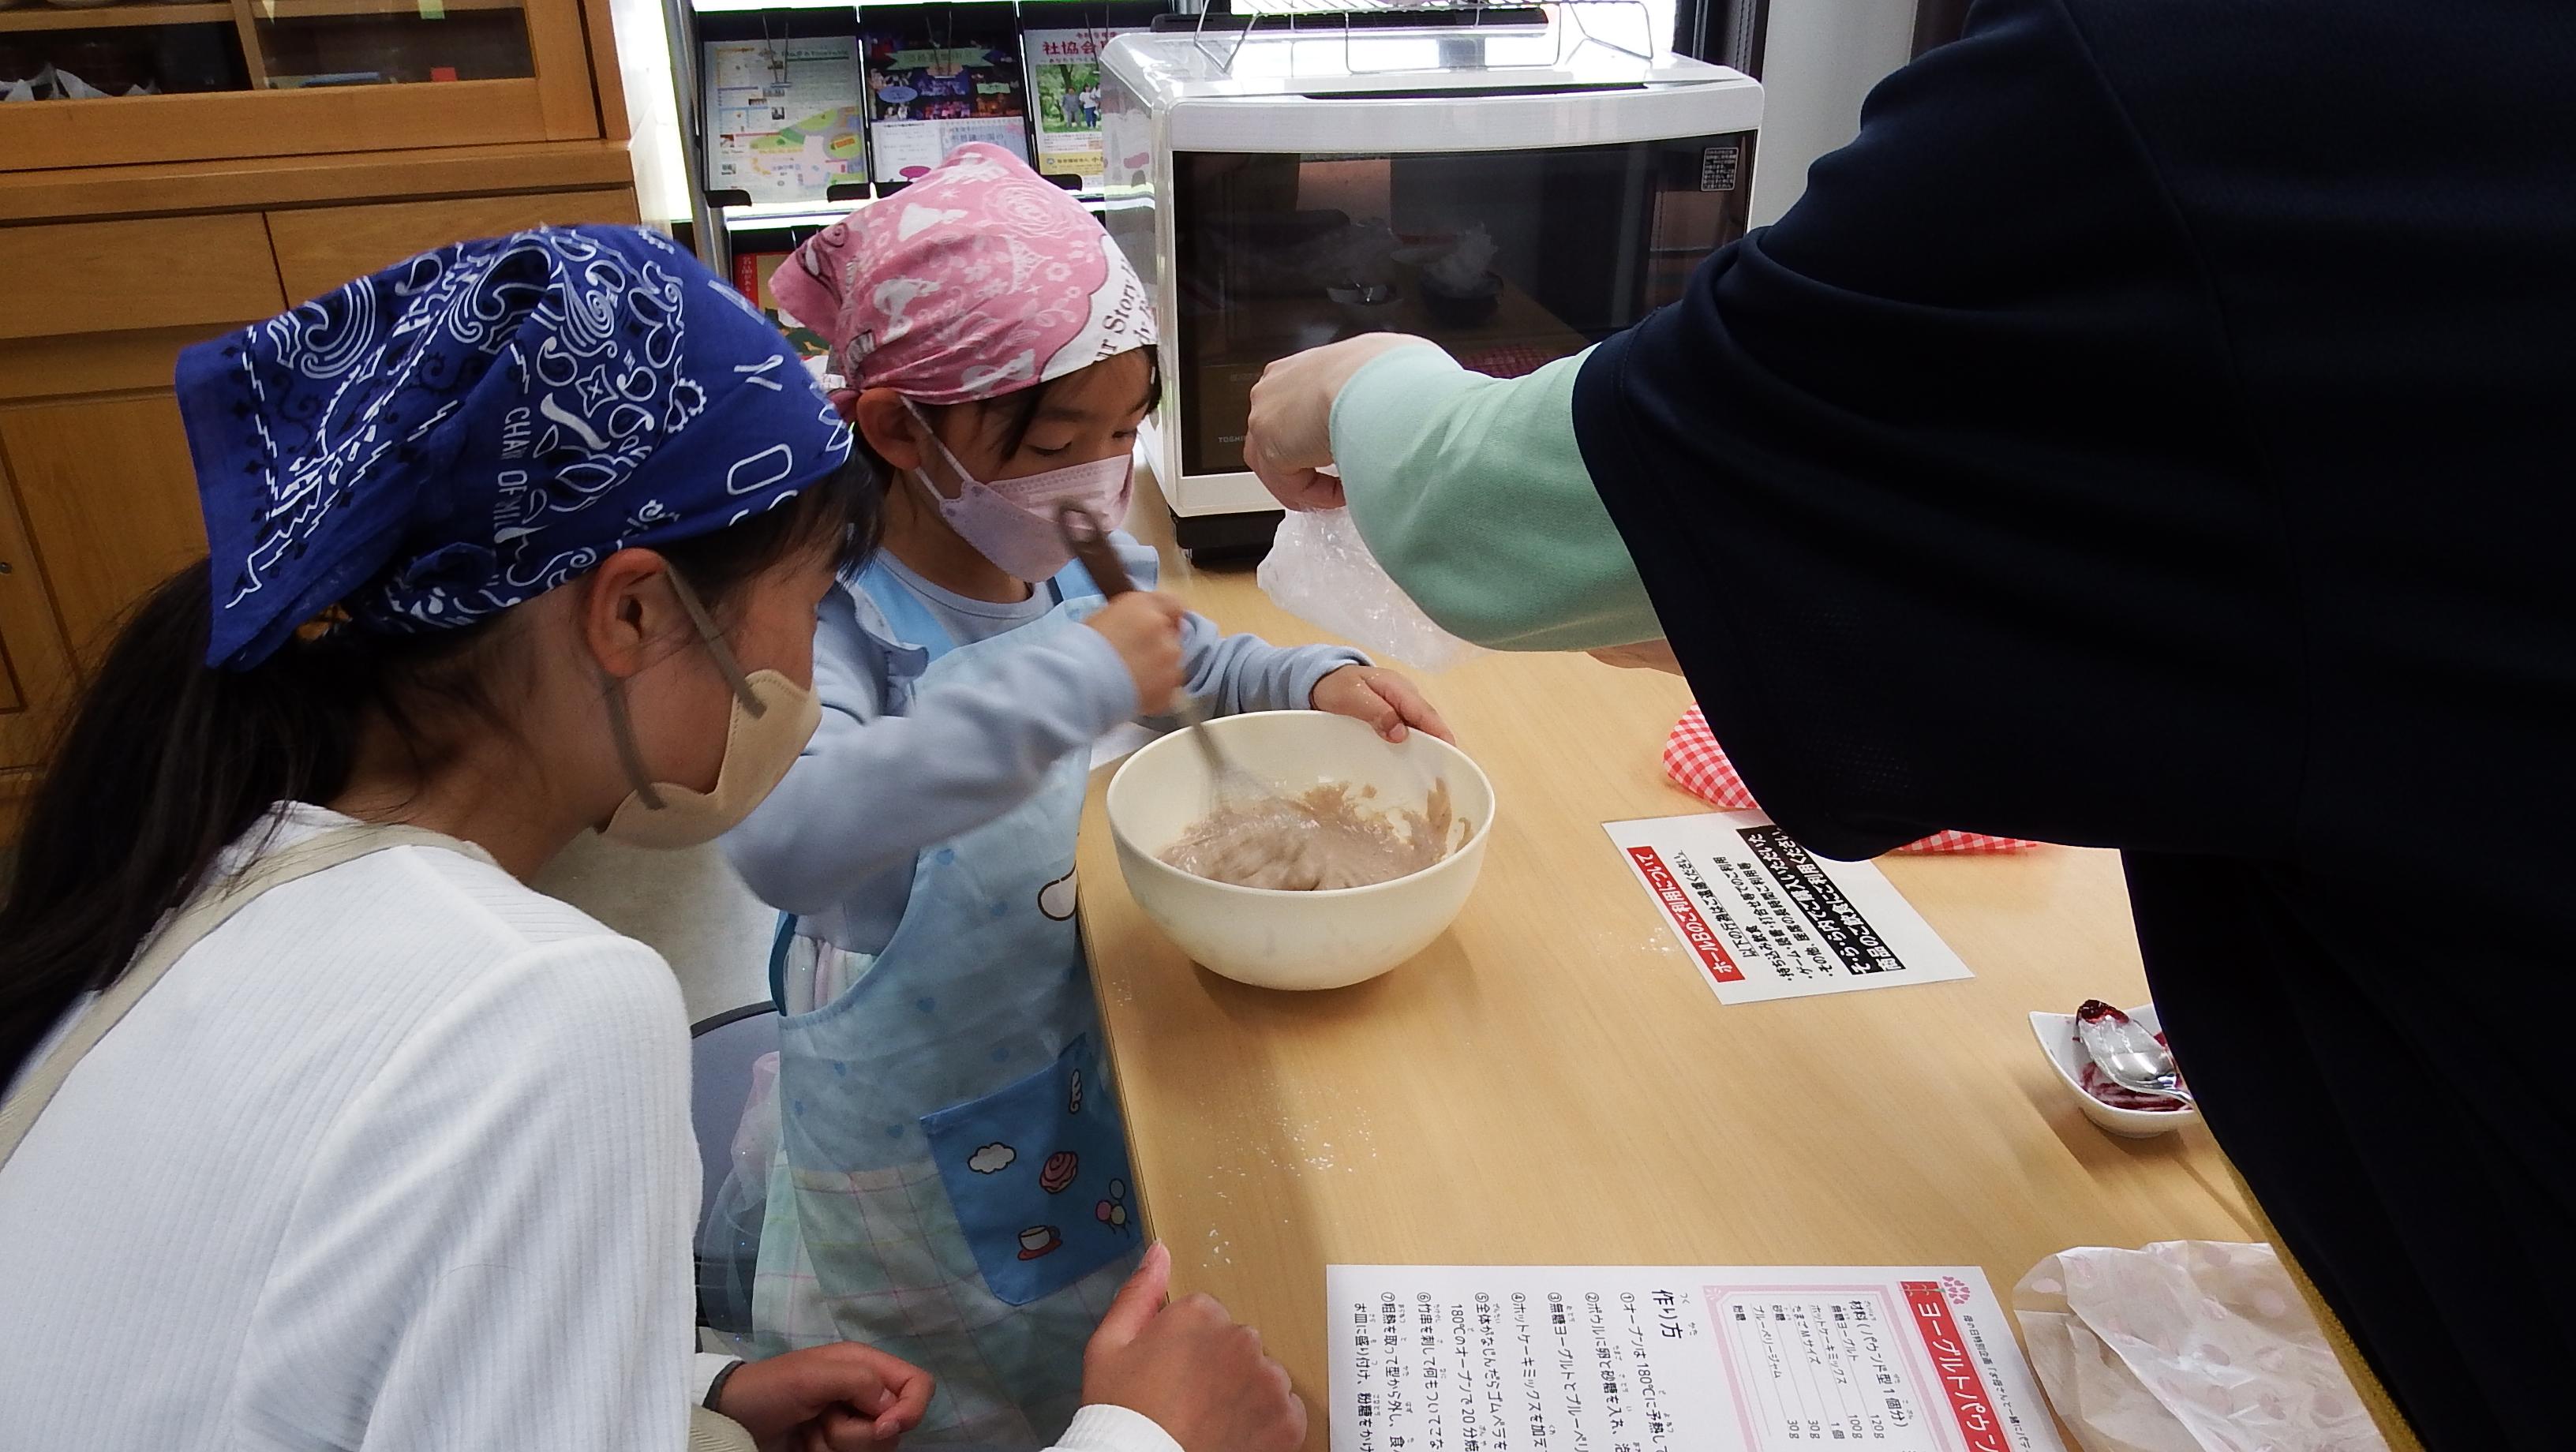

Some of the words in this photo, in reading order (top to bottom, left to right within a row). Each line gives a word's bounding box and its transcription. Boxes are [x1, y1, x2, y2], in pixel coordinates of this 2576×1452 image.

[1218, 435, 1245, 443] TOSHI
[1636, 853, 1733, 974] ホールBのご利用について
[1651, 1289, 1683, 1338] 作り方
[1511, 1292, 1548, 1452] ④ホットケーキミックスを加え
[1810, 1304, 1848, 1384] ホットケーキミックス
[1848, 1414, 1863, 1439] 100g
[1918, 1302, 1999, 1452] ヨーグルトパウン
[1963, 1315, 2031, 1452] 母の日特別企画「お母さんと一緒にパテ
[1787, 1420, 1800, 1439] 30g
[1808, 1420, 1821, 1439] 30g
[1870, 1414, 1885, 1439] 120g
